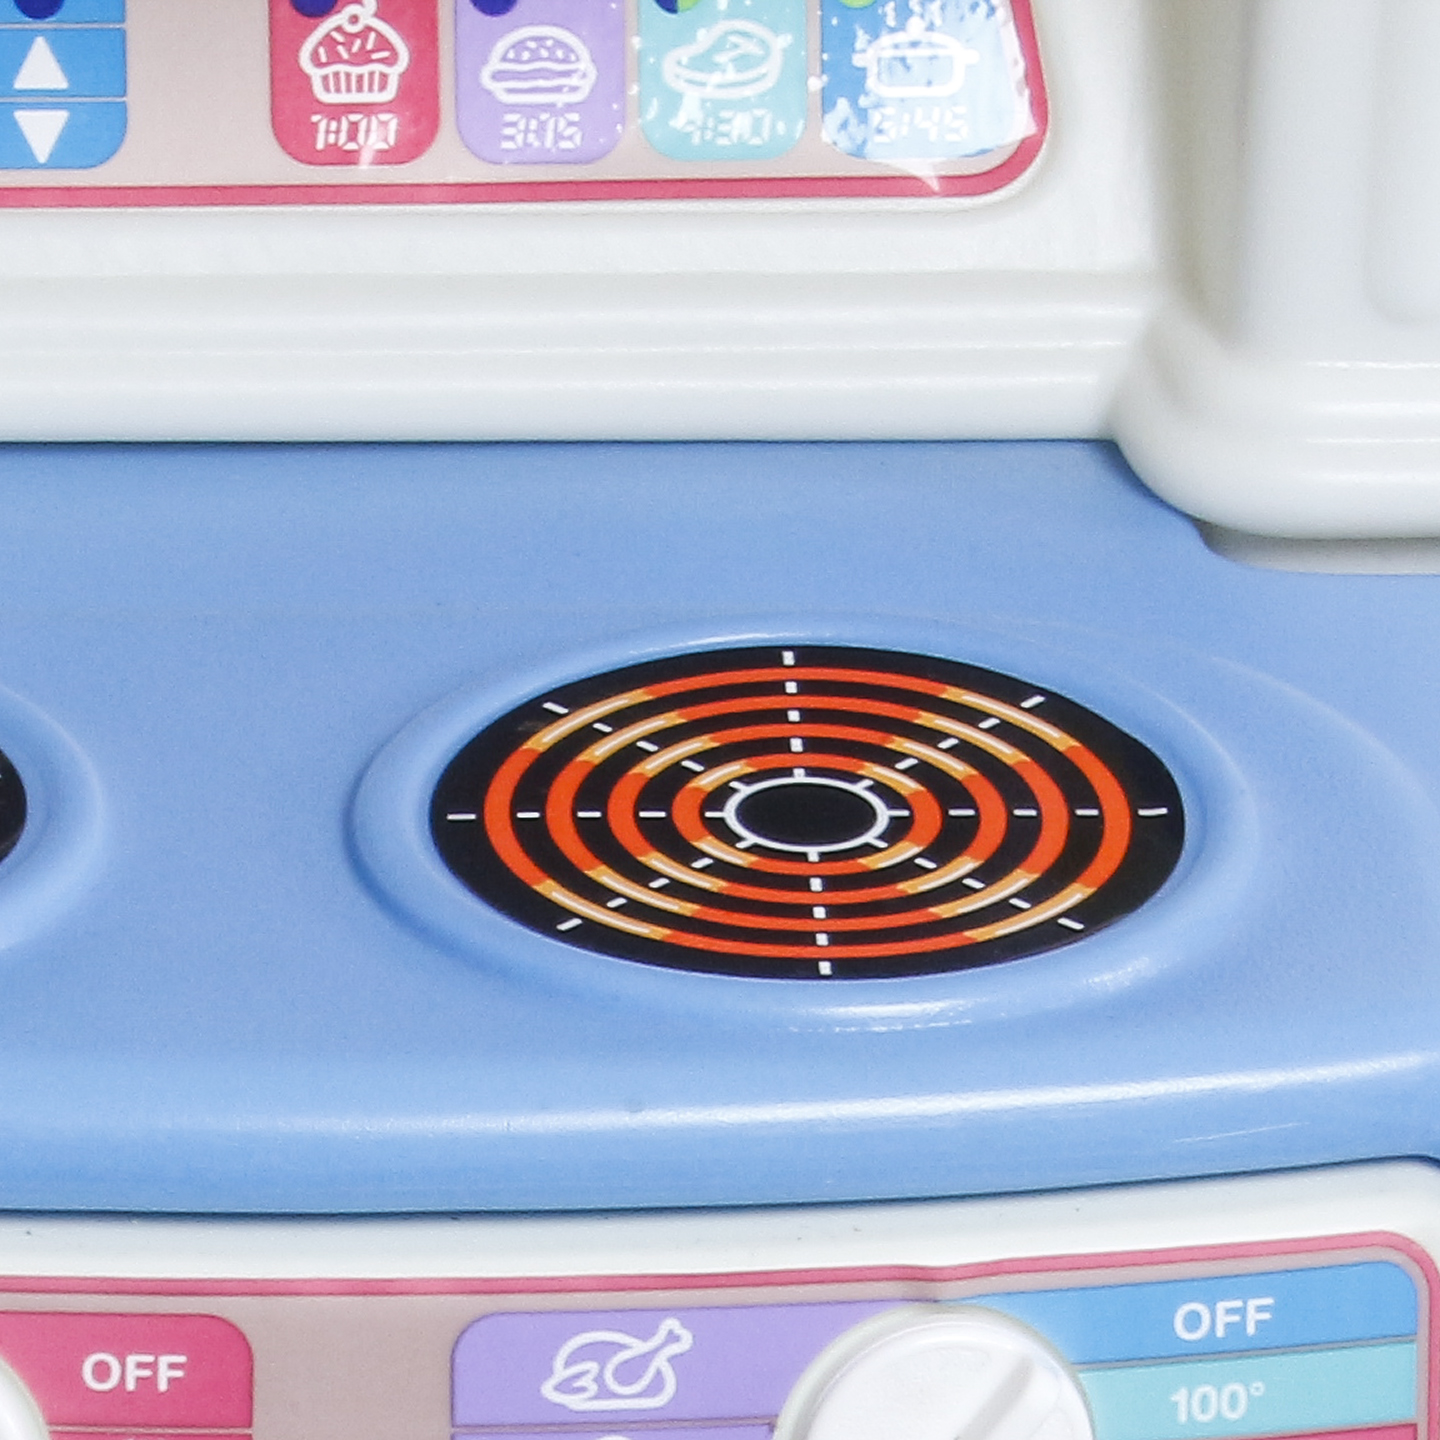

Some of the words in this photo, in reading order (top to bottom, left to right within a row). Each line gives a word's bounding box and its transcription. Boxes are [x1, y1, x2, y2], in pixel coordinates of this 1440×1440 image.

[310, 113, 399, 151] 1:00
[500, 112, 583, 150] 3:15
[1172, 1297, 1275, 1341] OFF
[81, 1352, 188, 1393] OFF
[1170, 1381, 1265, 1424] 100°
